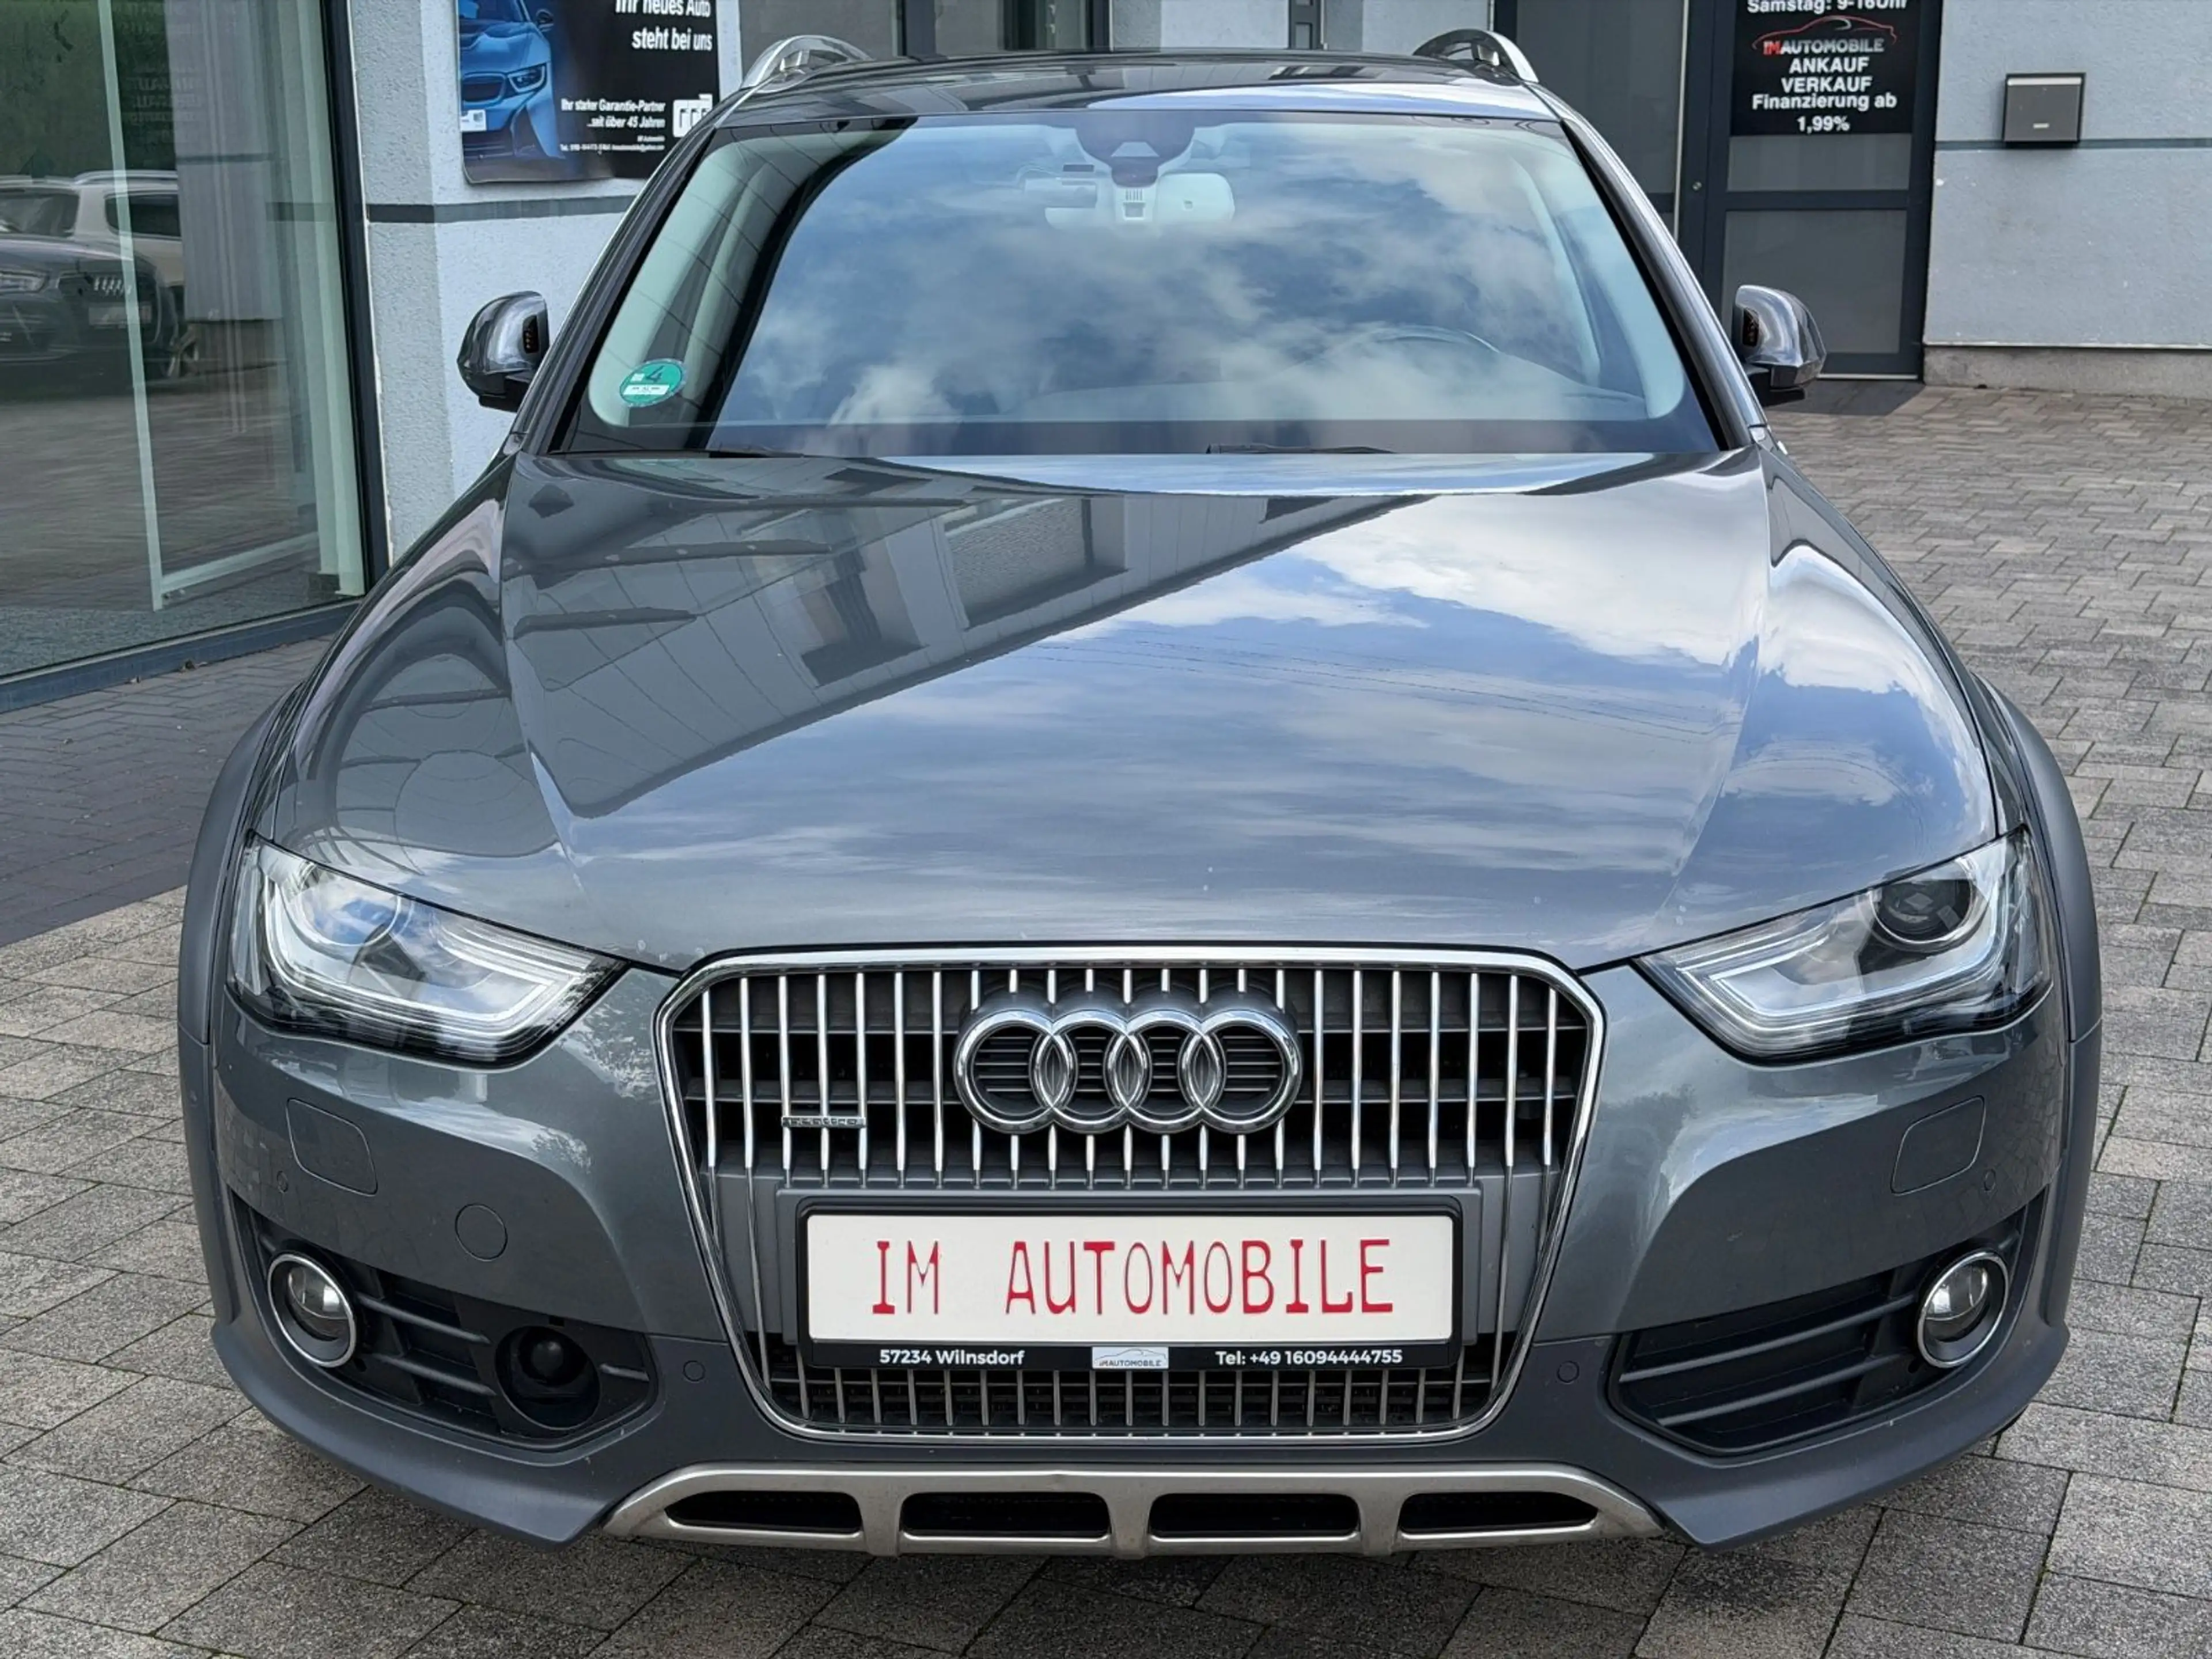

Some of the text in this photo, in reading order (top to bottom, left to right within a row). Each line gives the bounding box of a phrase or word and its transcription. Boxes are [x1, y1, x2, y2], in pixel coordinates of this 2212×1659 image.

[642, 0, 684, 16] neues
[685, 0, 711, 18] Auto
[1747, 0, 1832, 14] Samstag:
[632, 26, 713, 51] steht bei uns
[1789, 57, 1869, 74] ANKAUF
[1782, 76, 1872, 93] VERKAUF
[1752, 92, 1897, 112] Finanzierung ab
[1797, 116, 1850, 134] 1,99%
[646, 365, 665, 382] 4
[872, 1238, 1393, 1315] IM AUTOMOBILE
[879, 1349, 1025, 1365] 57234 Wilnsdorf
[1215, 1349, 1403, 1365] Tel: +49 16094444755
